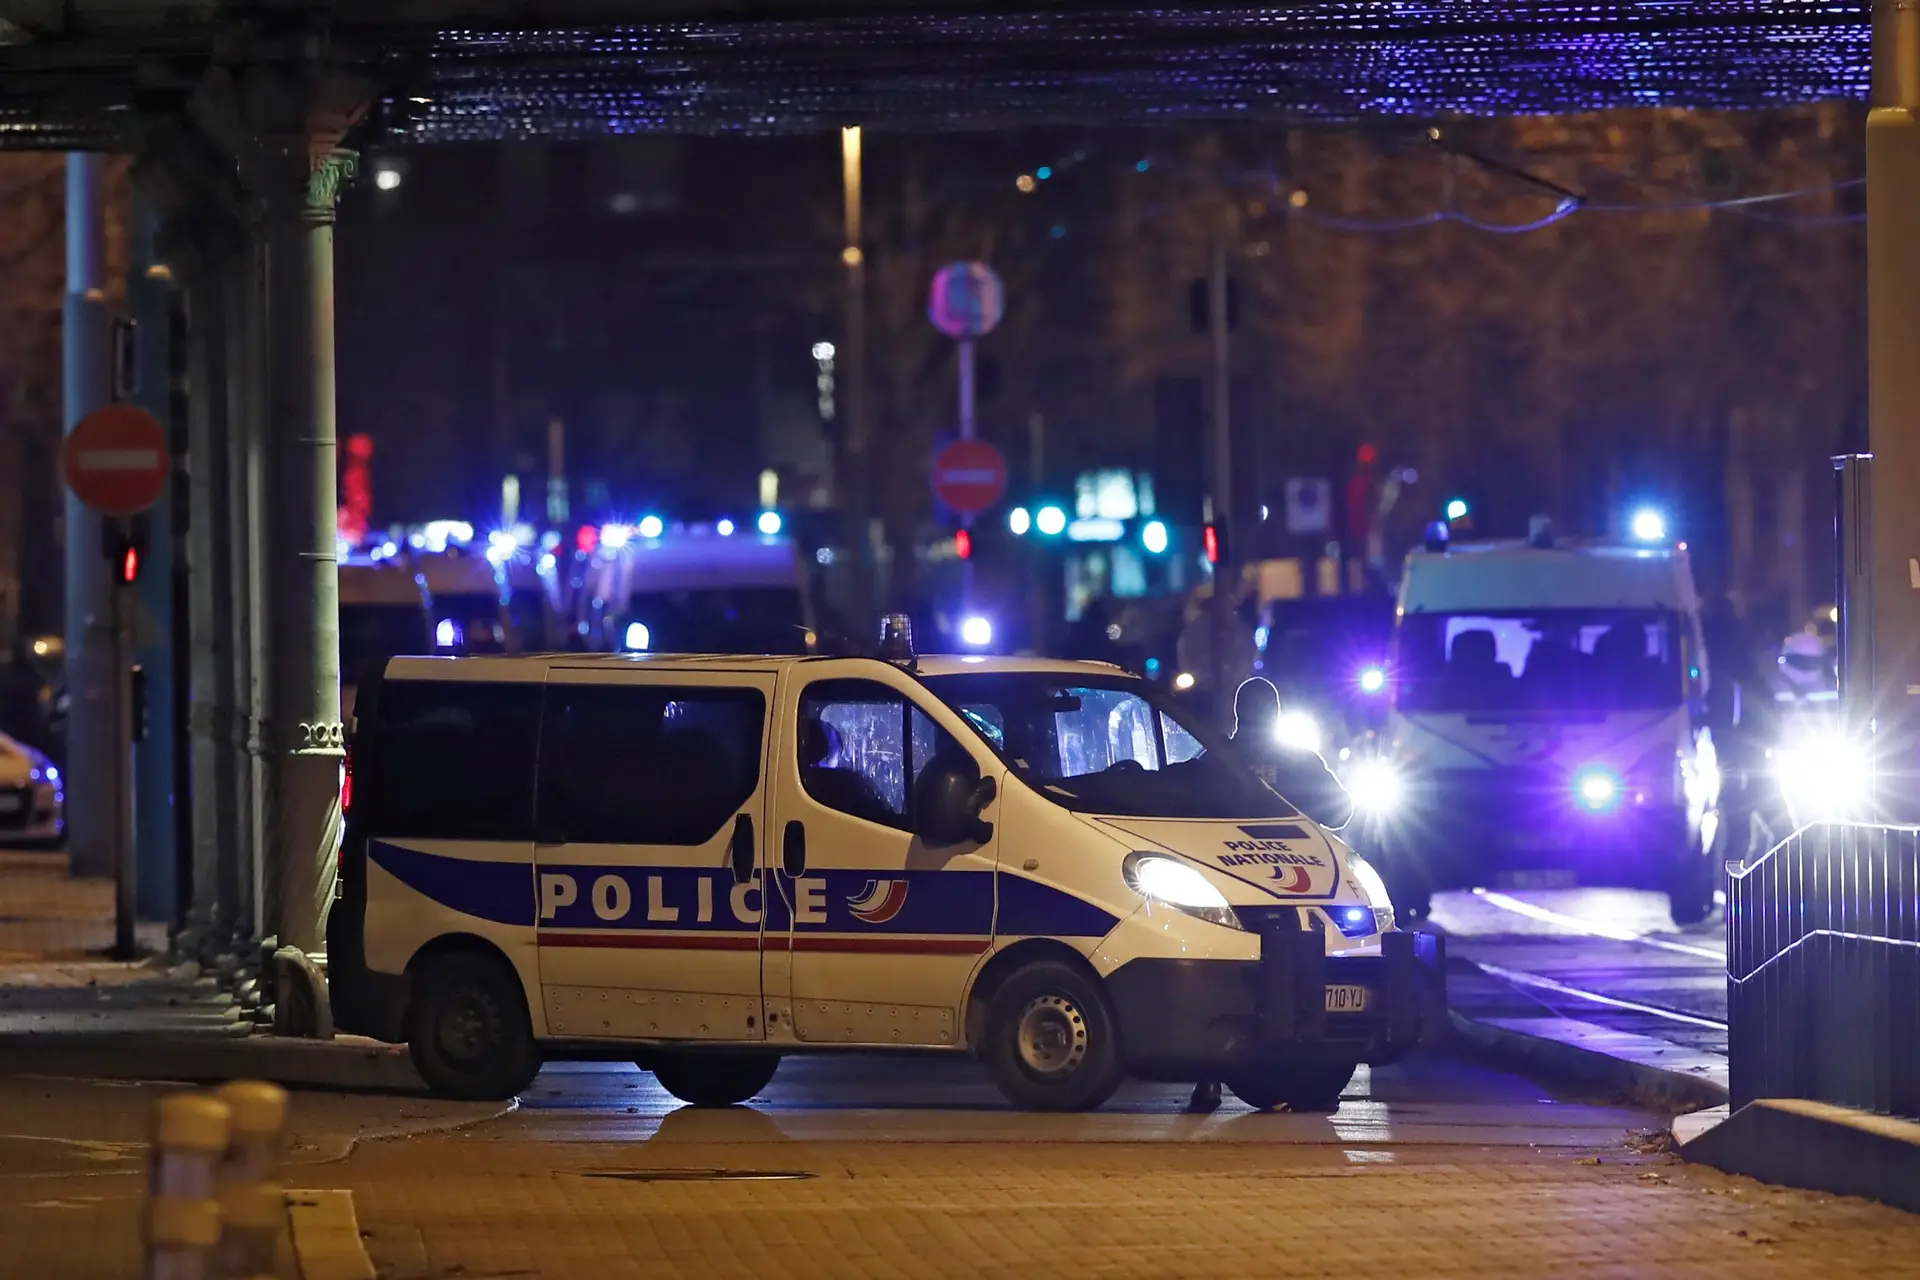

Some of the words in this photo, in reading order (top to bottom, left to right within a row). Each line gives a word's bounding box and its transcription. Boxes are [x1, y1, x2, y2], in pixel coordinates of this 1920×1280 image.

[1223, 841, 1292, 851] POLICE
[1216, 853, 1326, 867] NATIONALE
[540, 873, 827, 923] POLICE
